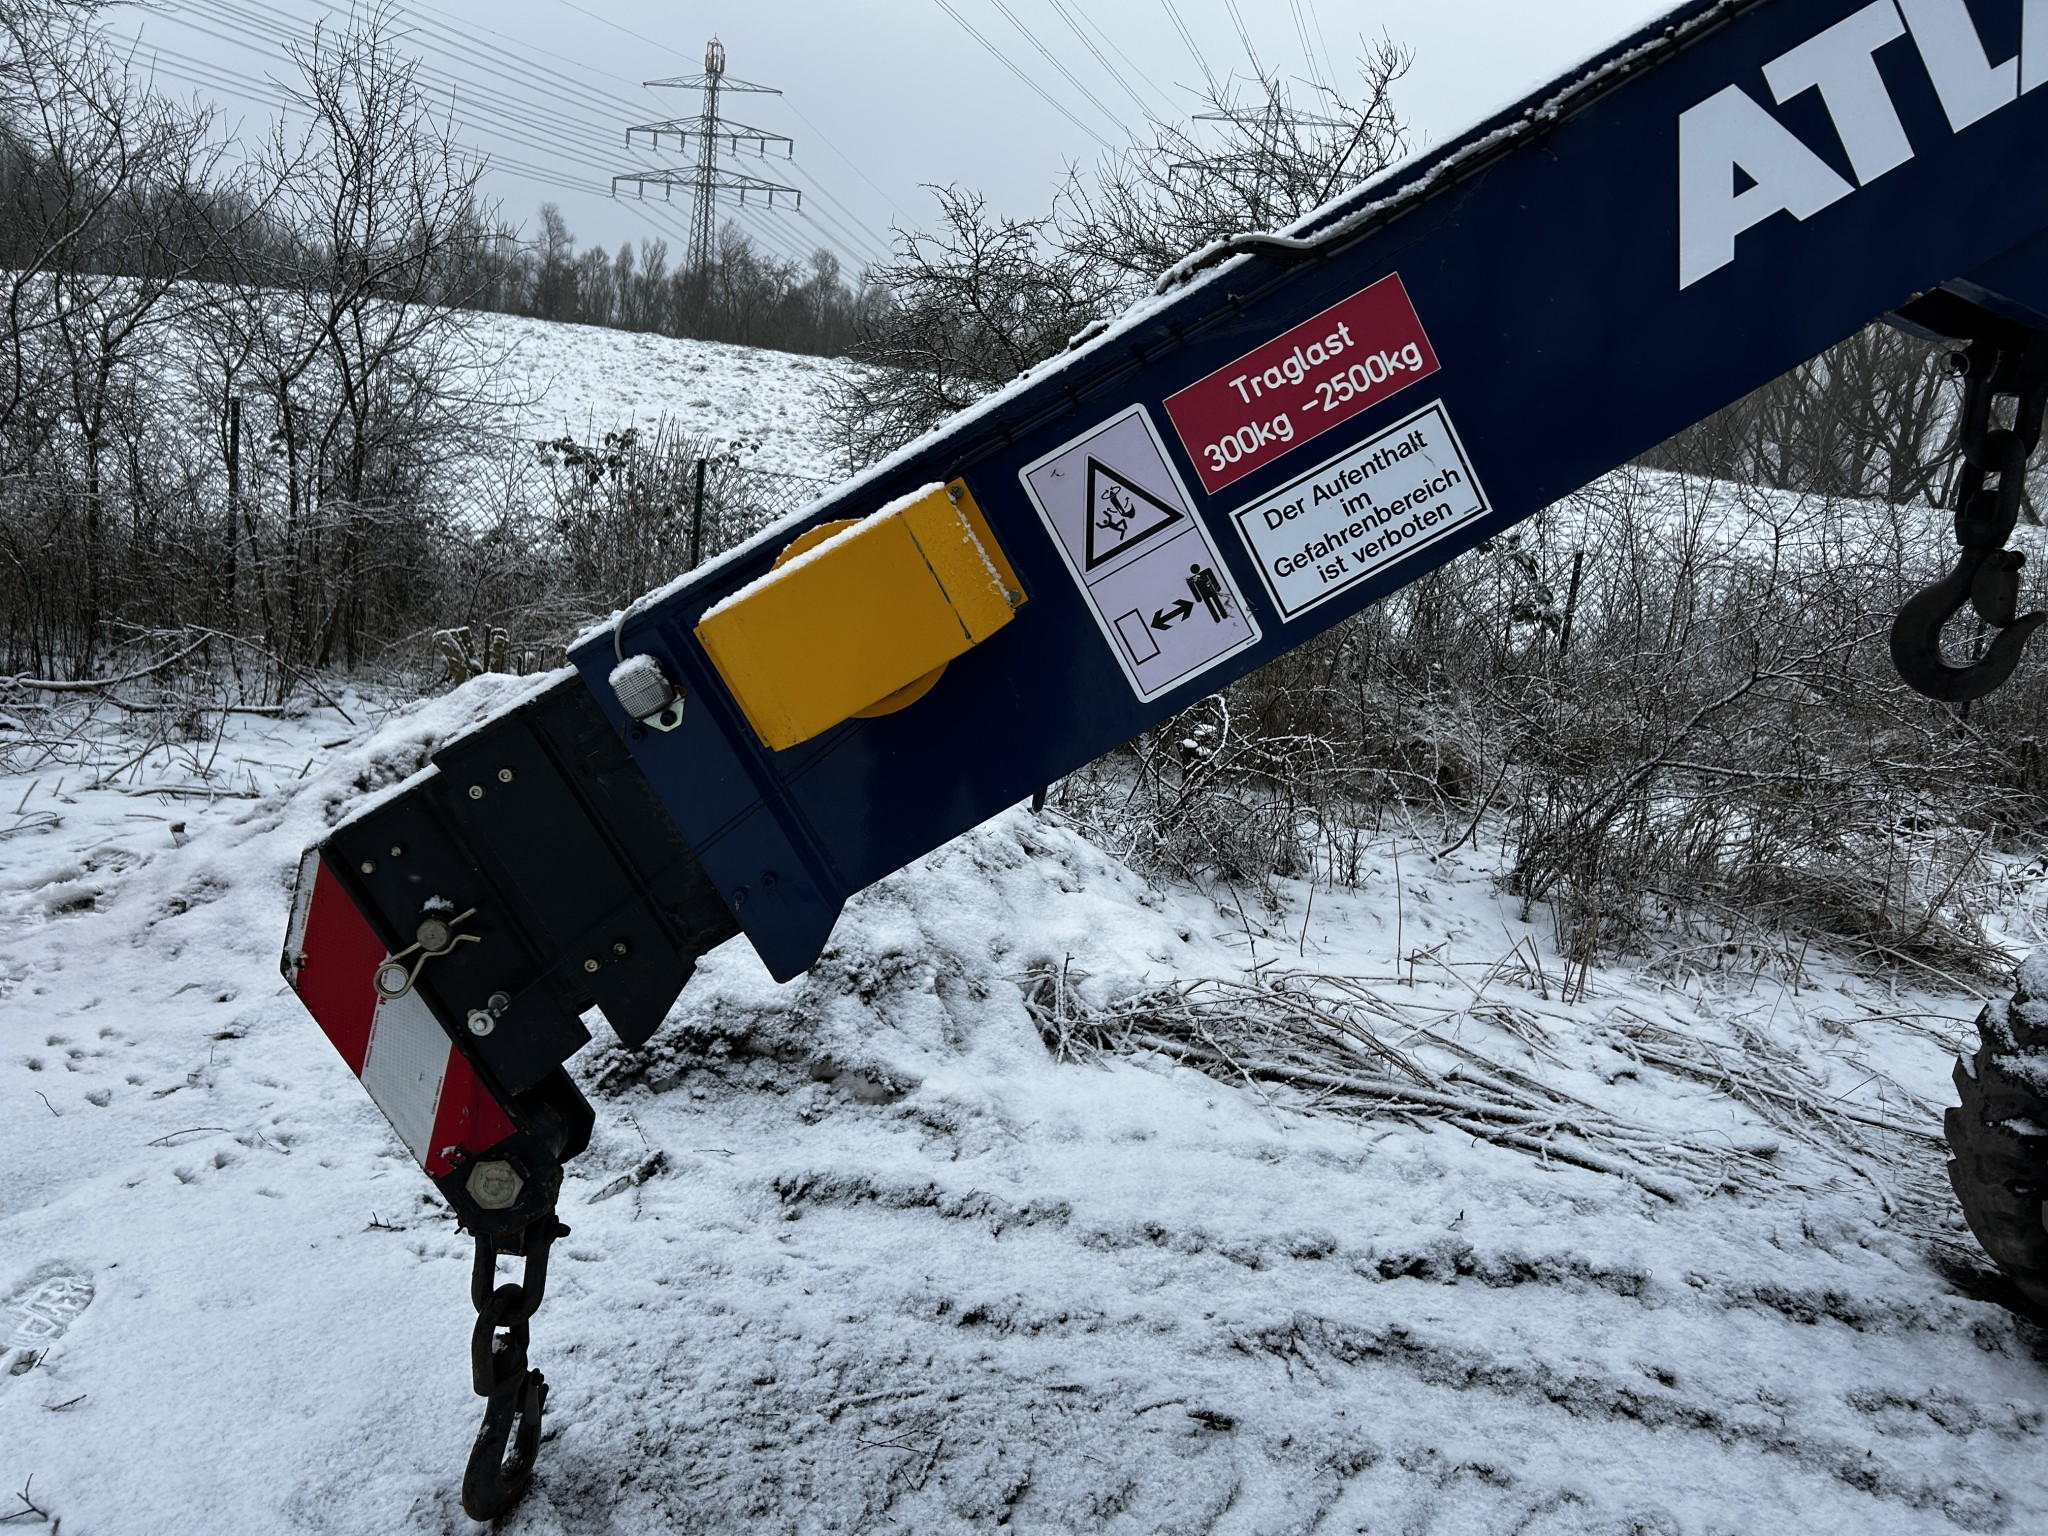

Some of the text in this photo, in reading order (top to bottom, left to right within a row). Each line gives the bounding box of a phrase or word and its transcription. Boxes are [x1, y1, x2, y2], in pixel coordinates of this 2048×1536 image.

[1679, 0, 2048, 291] ATL
[1228, 321, 1355, 404] Traglast
[1203, 412, 1295, 472] 300kg
[1262, 429, 1428, 531] Der Aufenthalt
[1273, 468, 1462, 578] Gefahrenbereich
[1315, 502, 1453, 584] ist verboten
[1339, 492, 1373, 517] im
